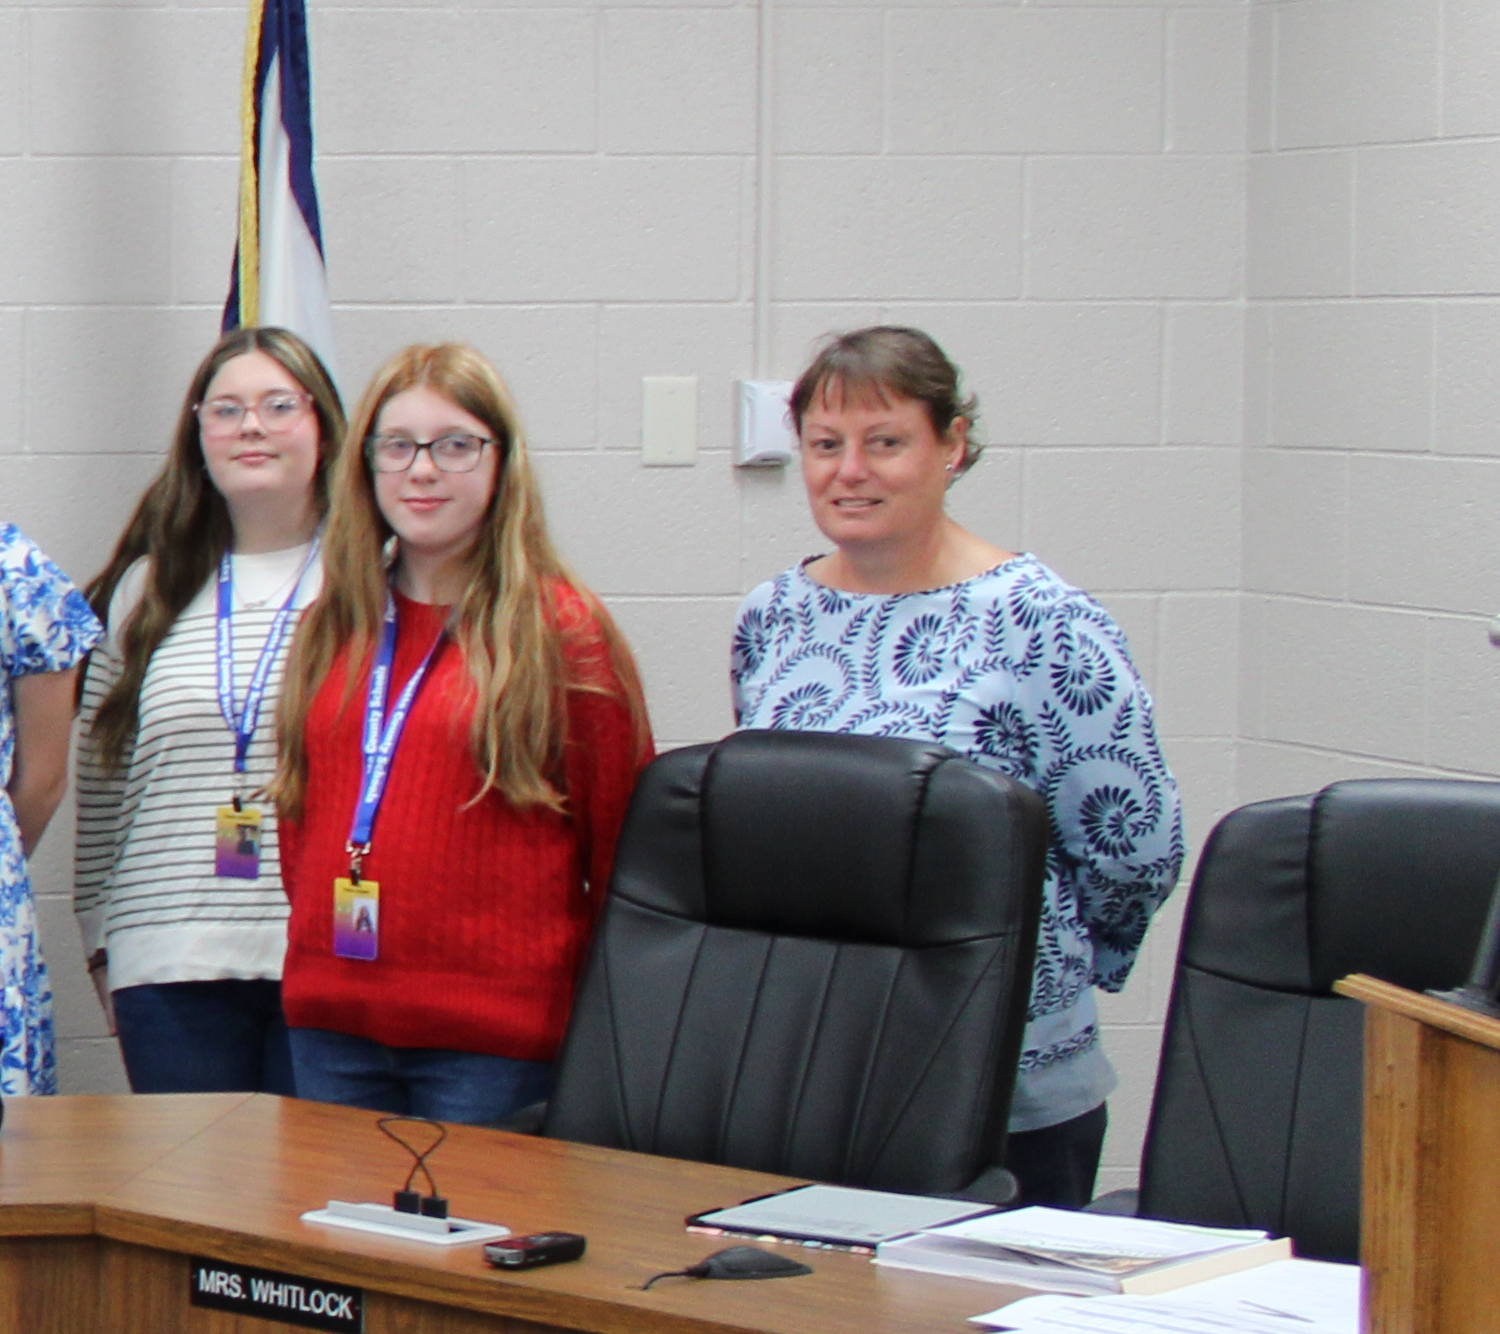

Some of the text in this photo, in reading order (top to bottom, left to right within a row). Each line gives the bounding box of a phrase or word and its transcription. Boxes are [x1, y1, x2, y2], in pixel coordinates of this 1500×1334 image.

[364, 710, 384, 754] County
[199, 1269, 353, 1319] MRS. WHITLOCK
